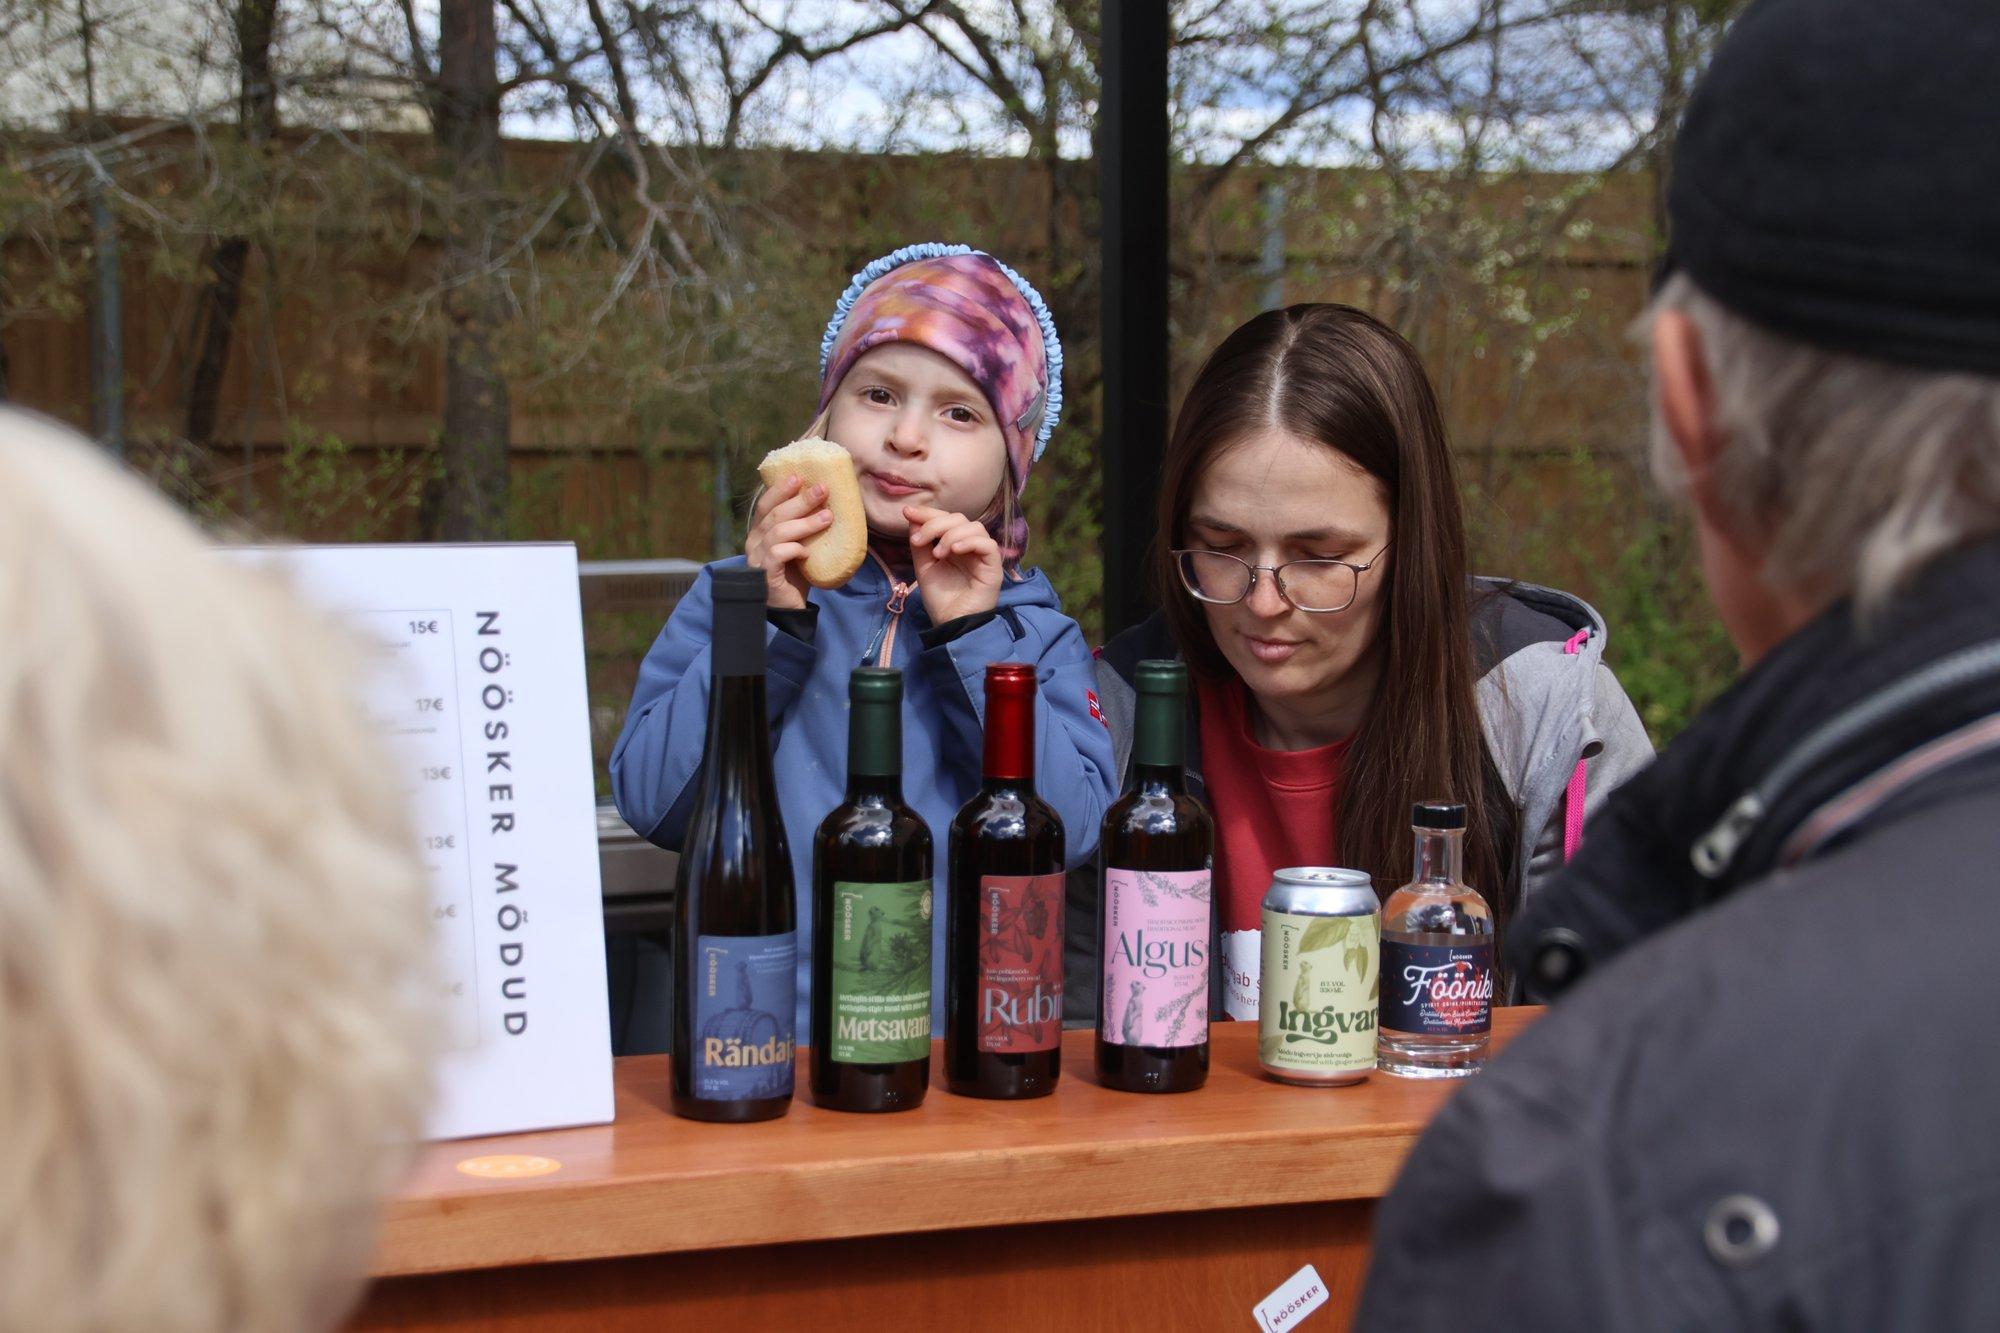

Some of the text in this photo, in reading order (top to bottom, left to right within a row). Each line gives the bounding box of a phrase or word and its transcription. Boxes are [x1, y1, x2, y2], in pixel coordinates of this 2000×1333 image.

[408, 619, 438, 634] 15€
[415, 698, 443, 712] 17€
[475, 611, 528, 1036] NÖÖSKER MÕDUD
[1110, 929, 1204, 979] Algus
[1272, 1285, 1320, 1325] NÖÖSKER
